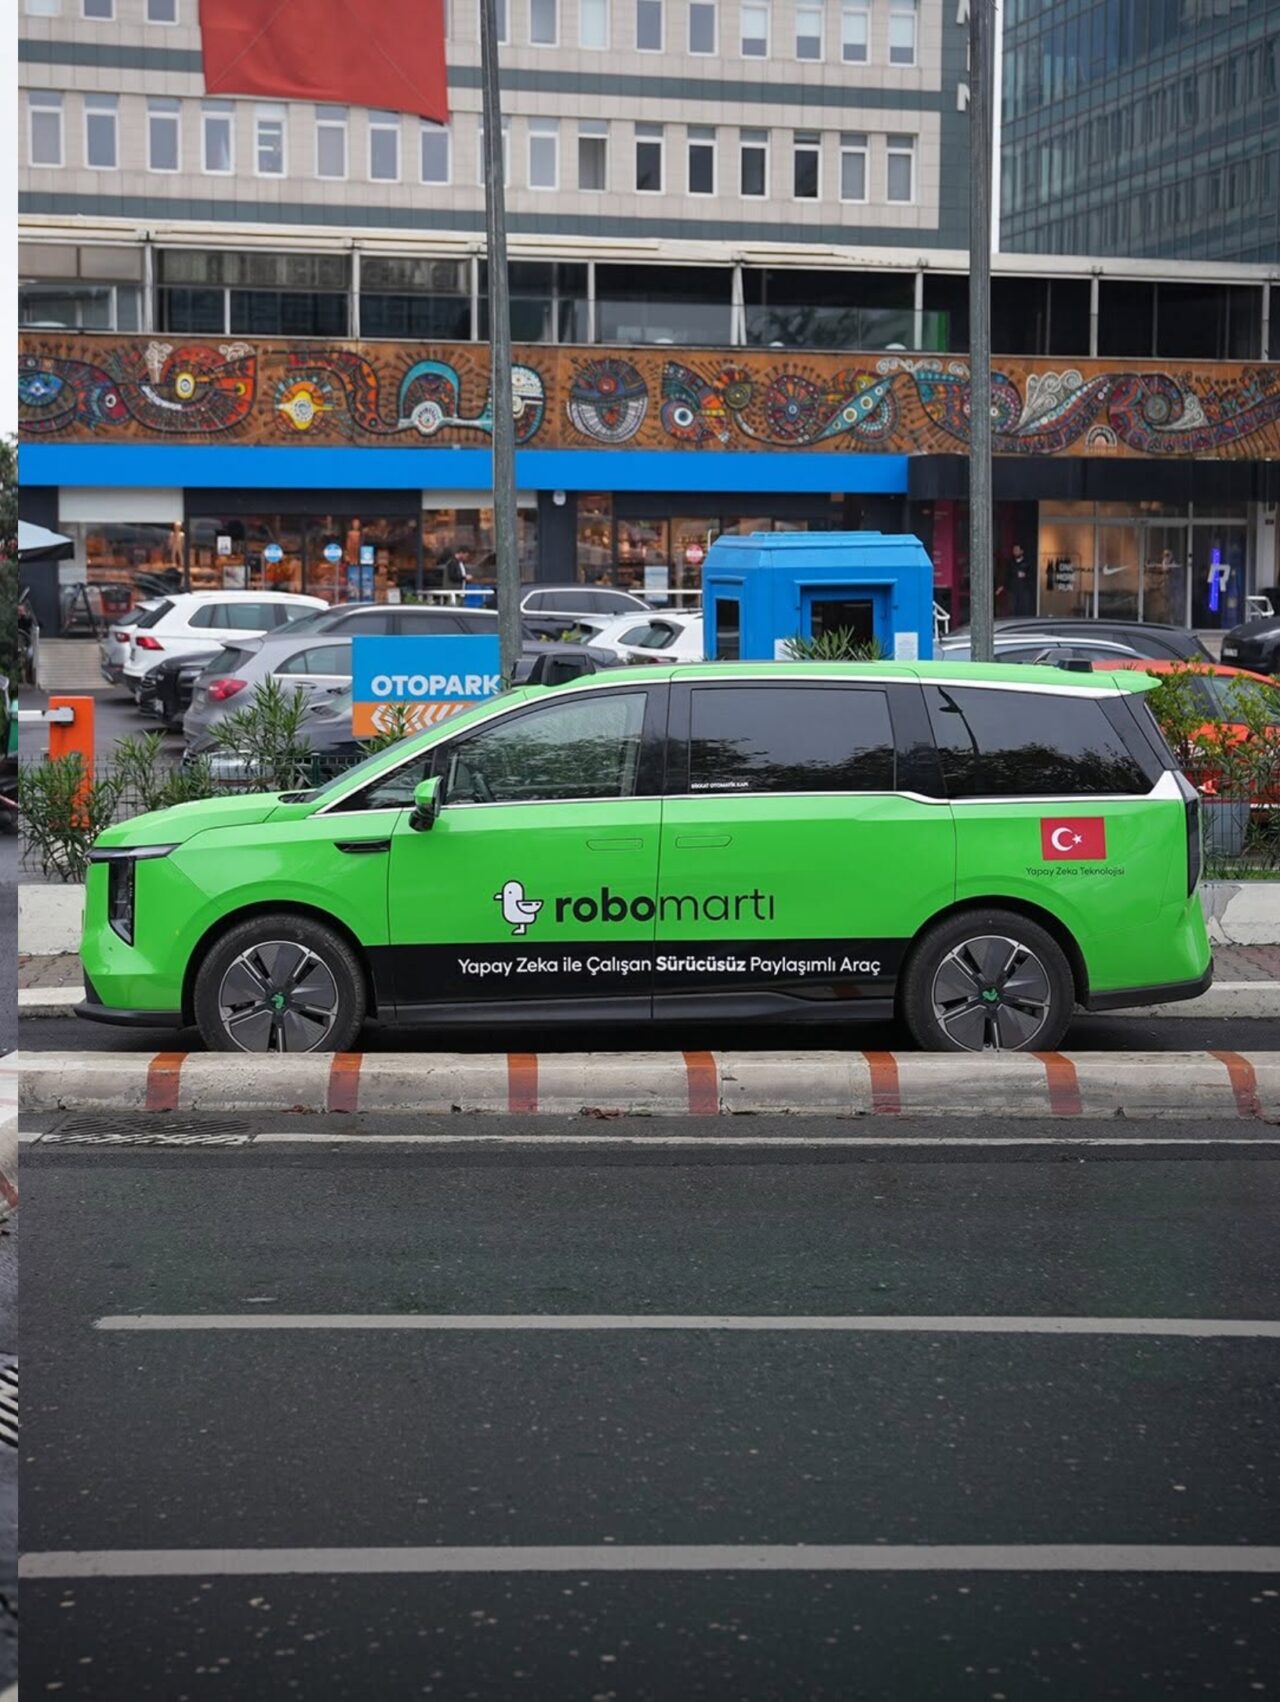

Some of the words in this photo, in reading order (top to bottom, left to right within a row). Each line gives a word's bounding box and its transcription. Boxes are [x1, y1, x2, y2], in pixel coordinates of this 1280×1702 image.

[370, 674, 500, 697] OTOPARK
[1025, 867, 1054, 876] Yapay
[1056, 867, 1078, 875] Zeka
[458, 957, 512, 977] Yapay
[516, 957, 558, 973] Zeka
[563, 956, 582, 972] ile
[586, 956, 651, 976] Çalışan
[656, 956, 746, 971] Sürücüsüz
[750, 956, 836, 975] Paylaşımlı
[840, 956, 880, 975] Araç
